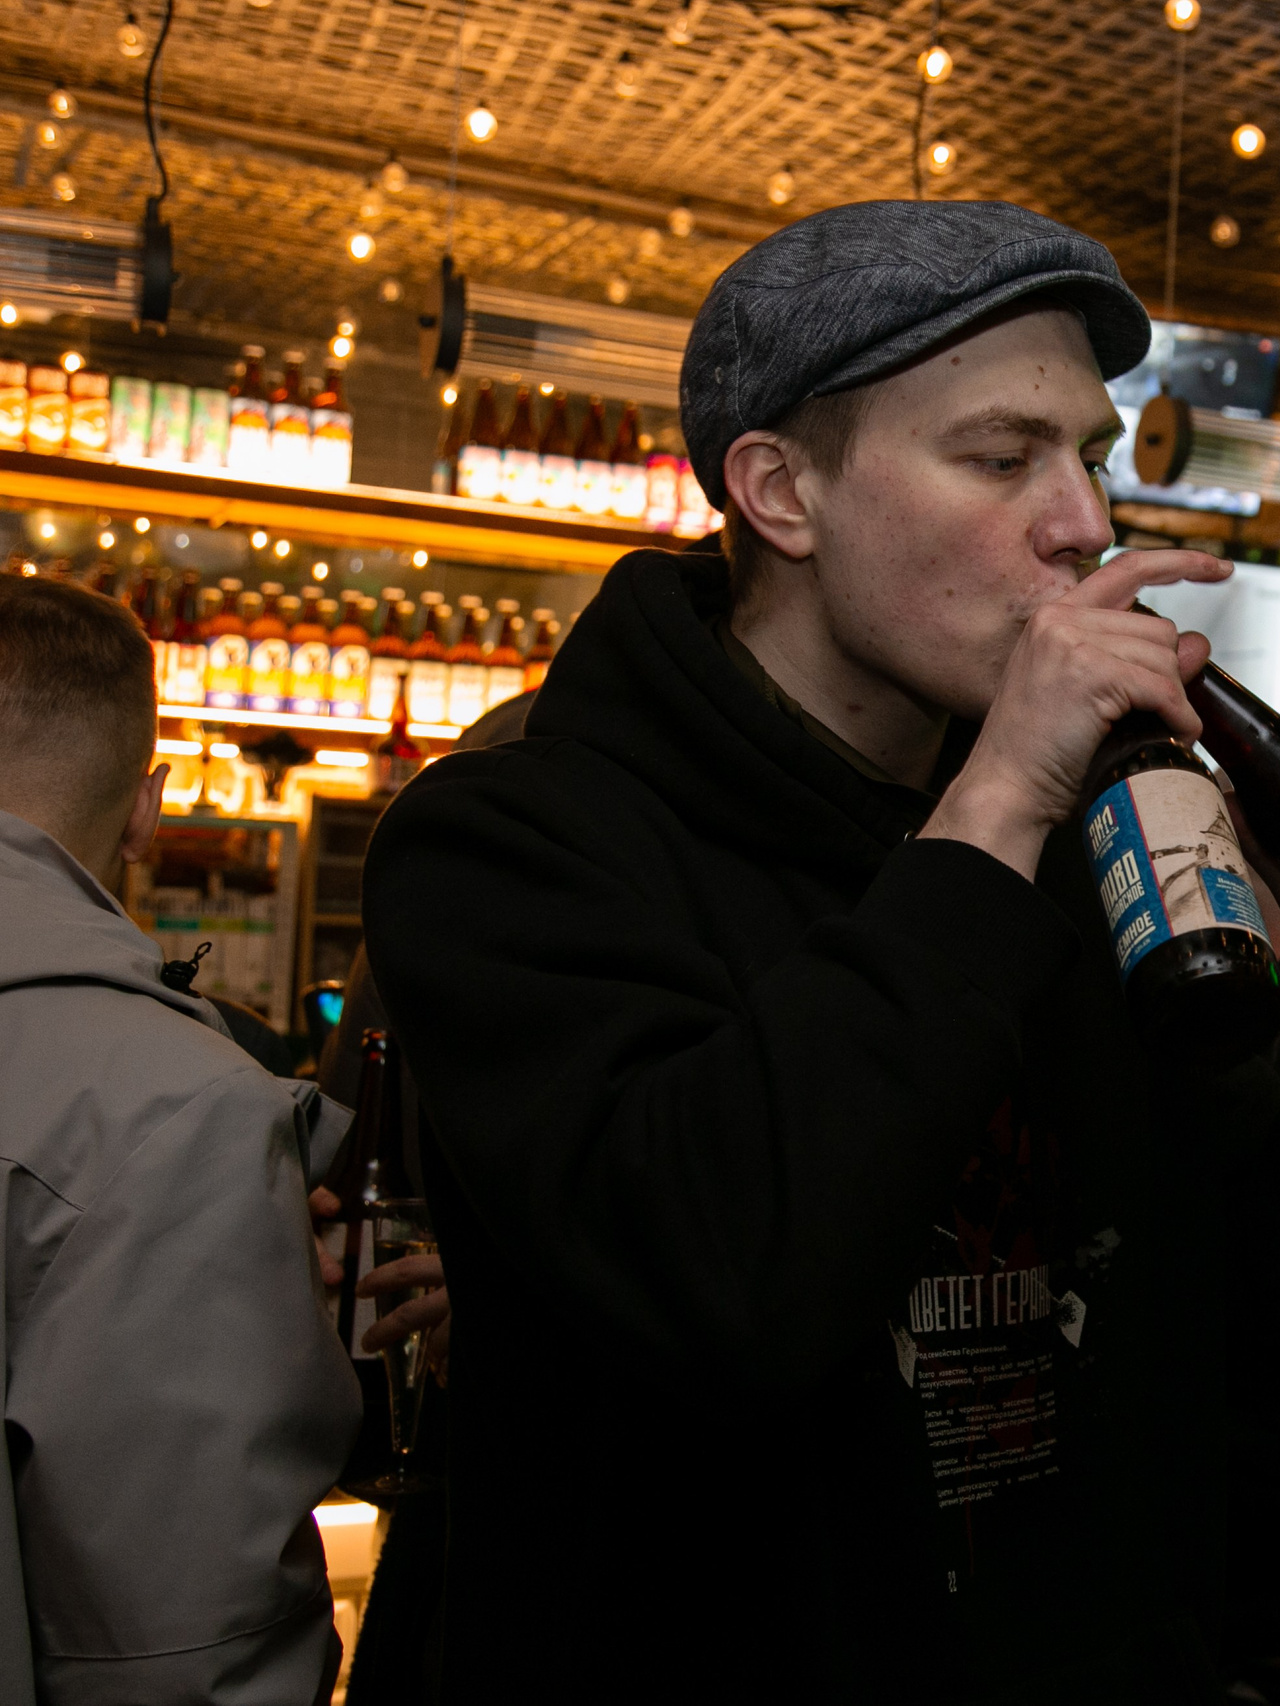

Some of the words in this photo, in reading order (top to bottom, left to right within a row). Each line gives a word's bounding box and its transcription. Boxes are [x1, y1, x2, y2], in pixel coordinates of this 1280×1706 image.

[1100, 849, 1141, 916] ПИВО
[908, 1274, 984, 1333] ЦВЕТЕТ
[928, 1348, 961, 1359] семейства
